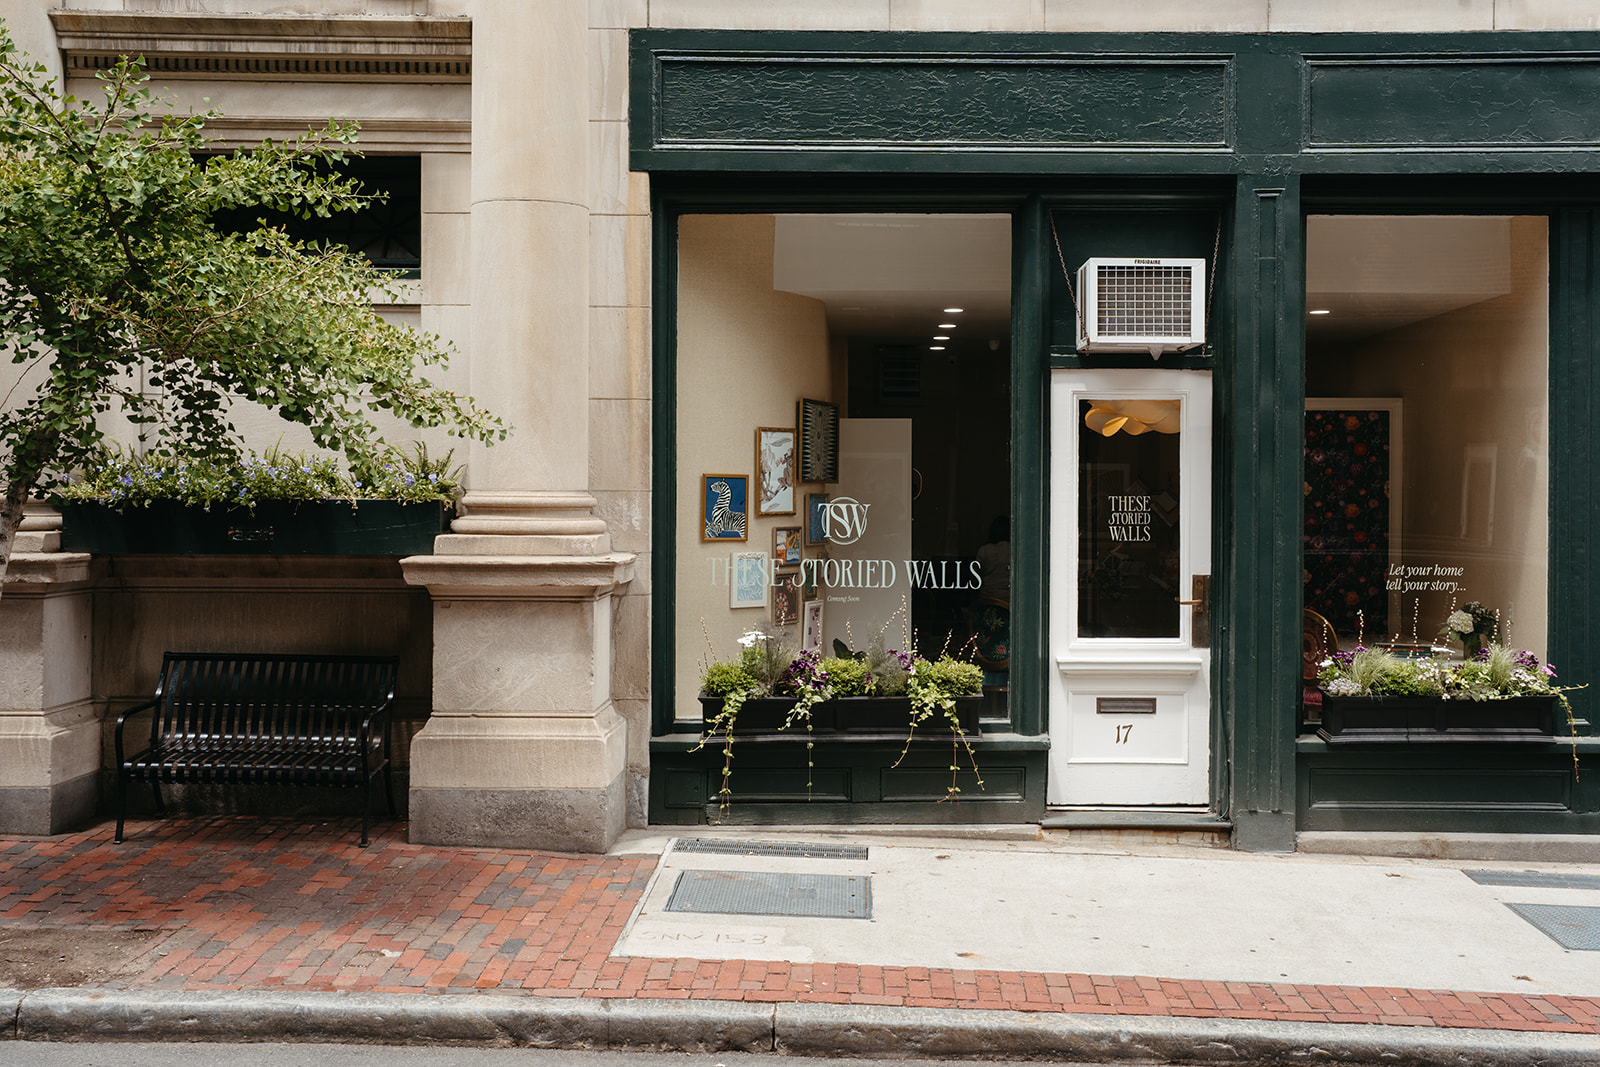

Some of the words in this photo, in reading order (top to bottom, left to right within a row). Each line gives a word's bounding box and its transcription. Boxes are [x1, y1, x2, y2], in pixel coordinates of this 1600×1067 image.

[1108, 495, 1151, 512] THESE
[818, 503, 871, 538] TSW
[1108, 512, 1151, 525] STORIED
[1109, 525, 1151, 542] WALLS
[707, 558, 784, 587] THESE
[792, 558, 897, 589] STORIED
[904, 560, 982, 590] WALLS
[1389, 563, 1405, 576] Let
[1405, 565, 1433, 579] your
[1433, 563, 1464, 577] home
[1385, 578, 1402, 591] tell
[1402, 580, 1430, 594] your
[1430, 579, 1467, 594] story...
[827, 594, 847, 603] Coming
[1115, 724, 1133, 745] 17
